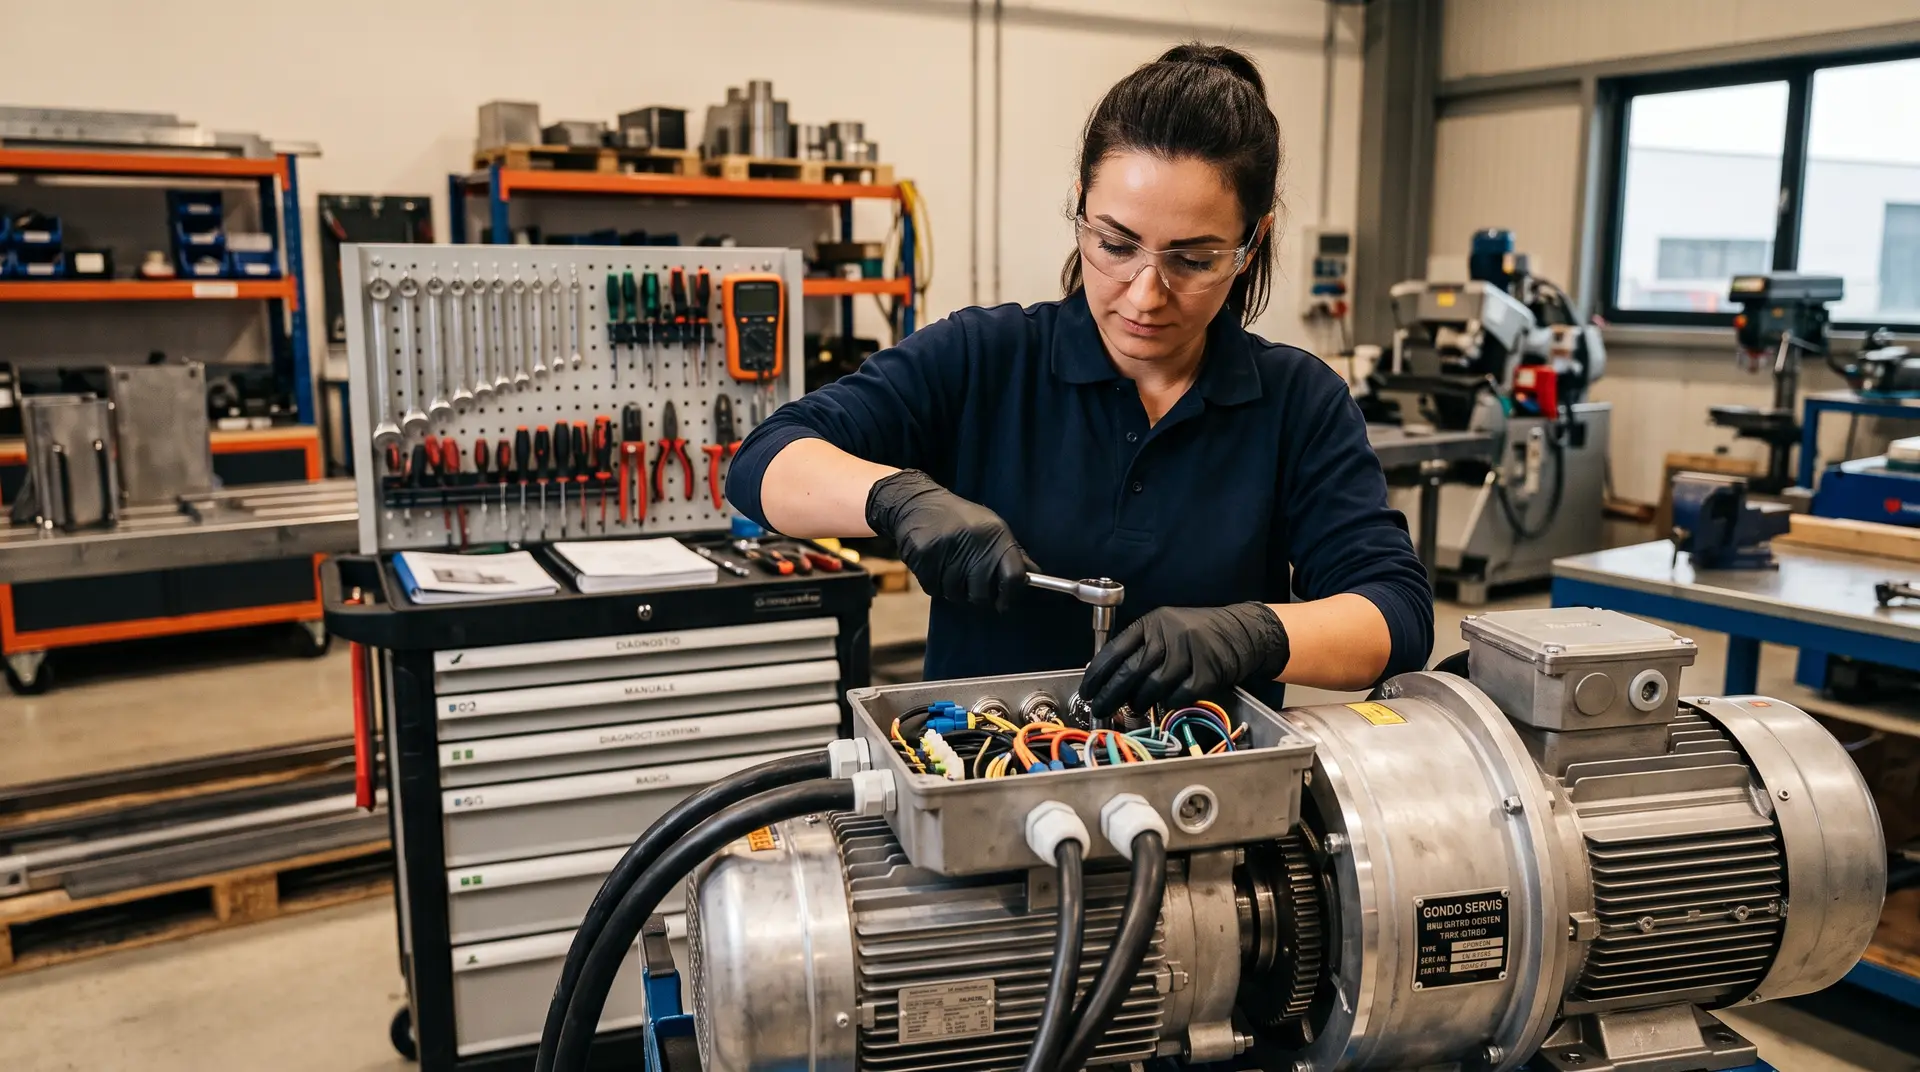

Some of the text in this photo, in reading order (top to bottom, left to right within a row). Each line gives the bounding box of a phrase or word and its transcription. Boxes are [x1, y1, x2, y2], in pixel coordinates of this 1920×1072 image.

[1423, 899, 1502, 918] GONDO SERVIS
[1421, 945, 1436, 953] TYPE
